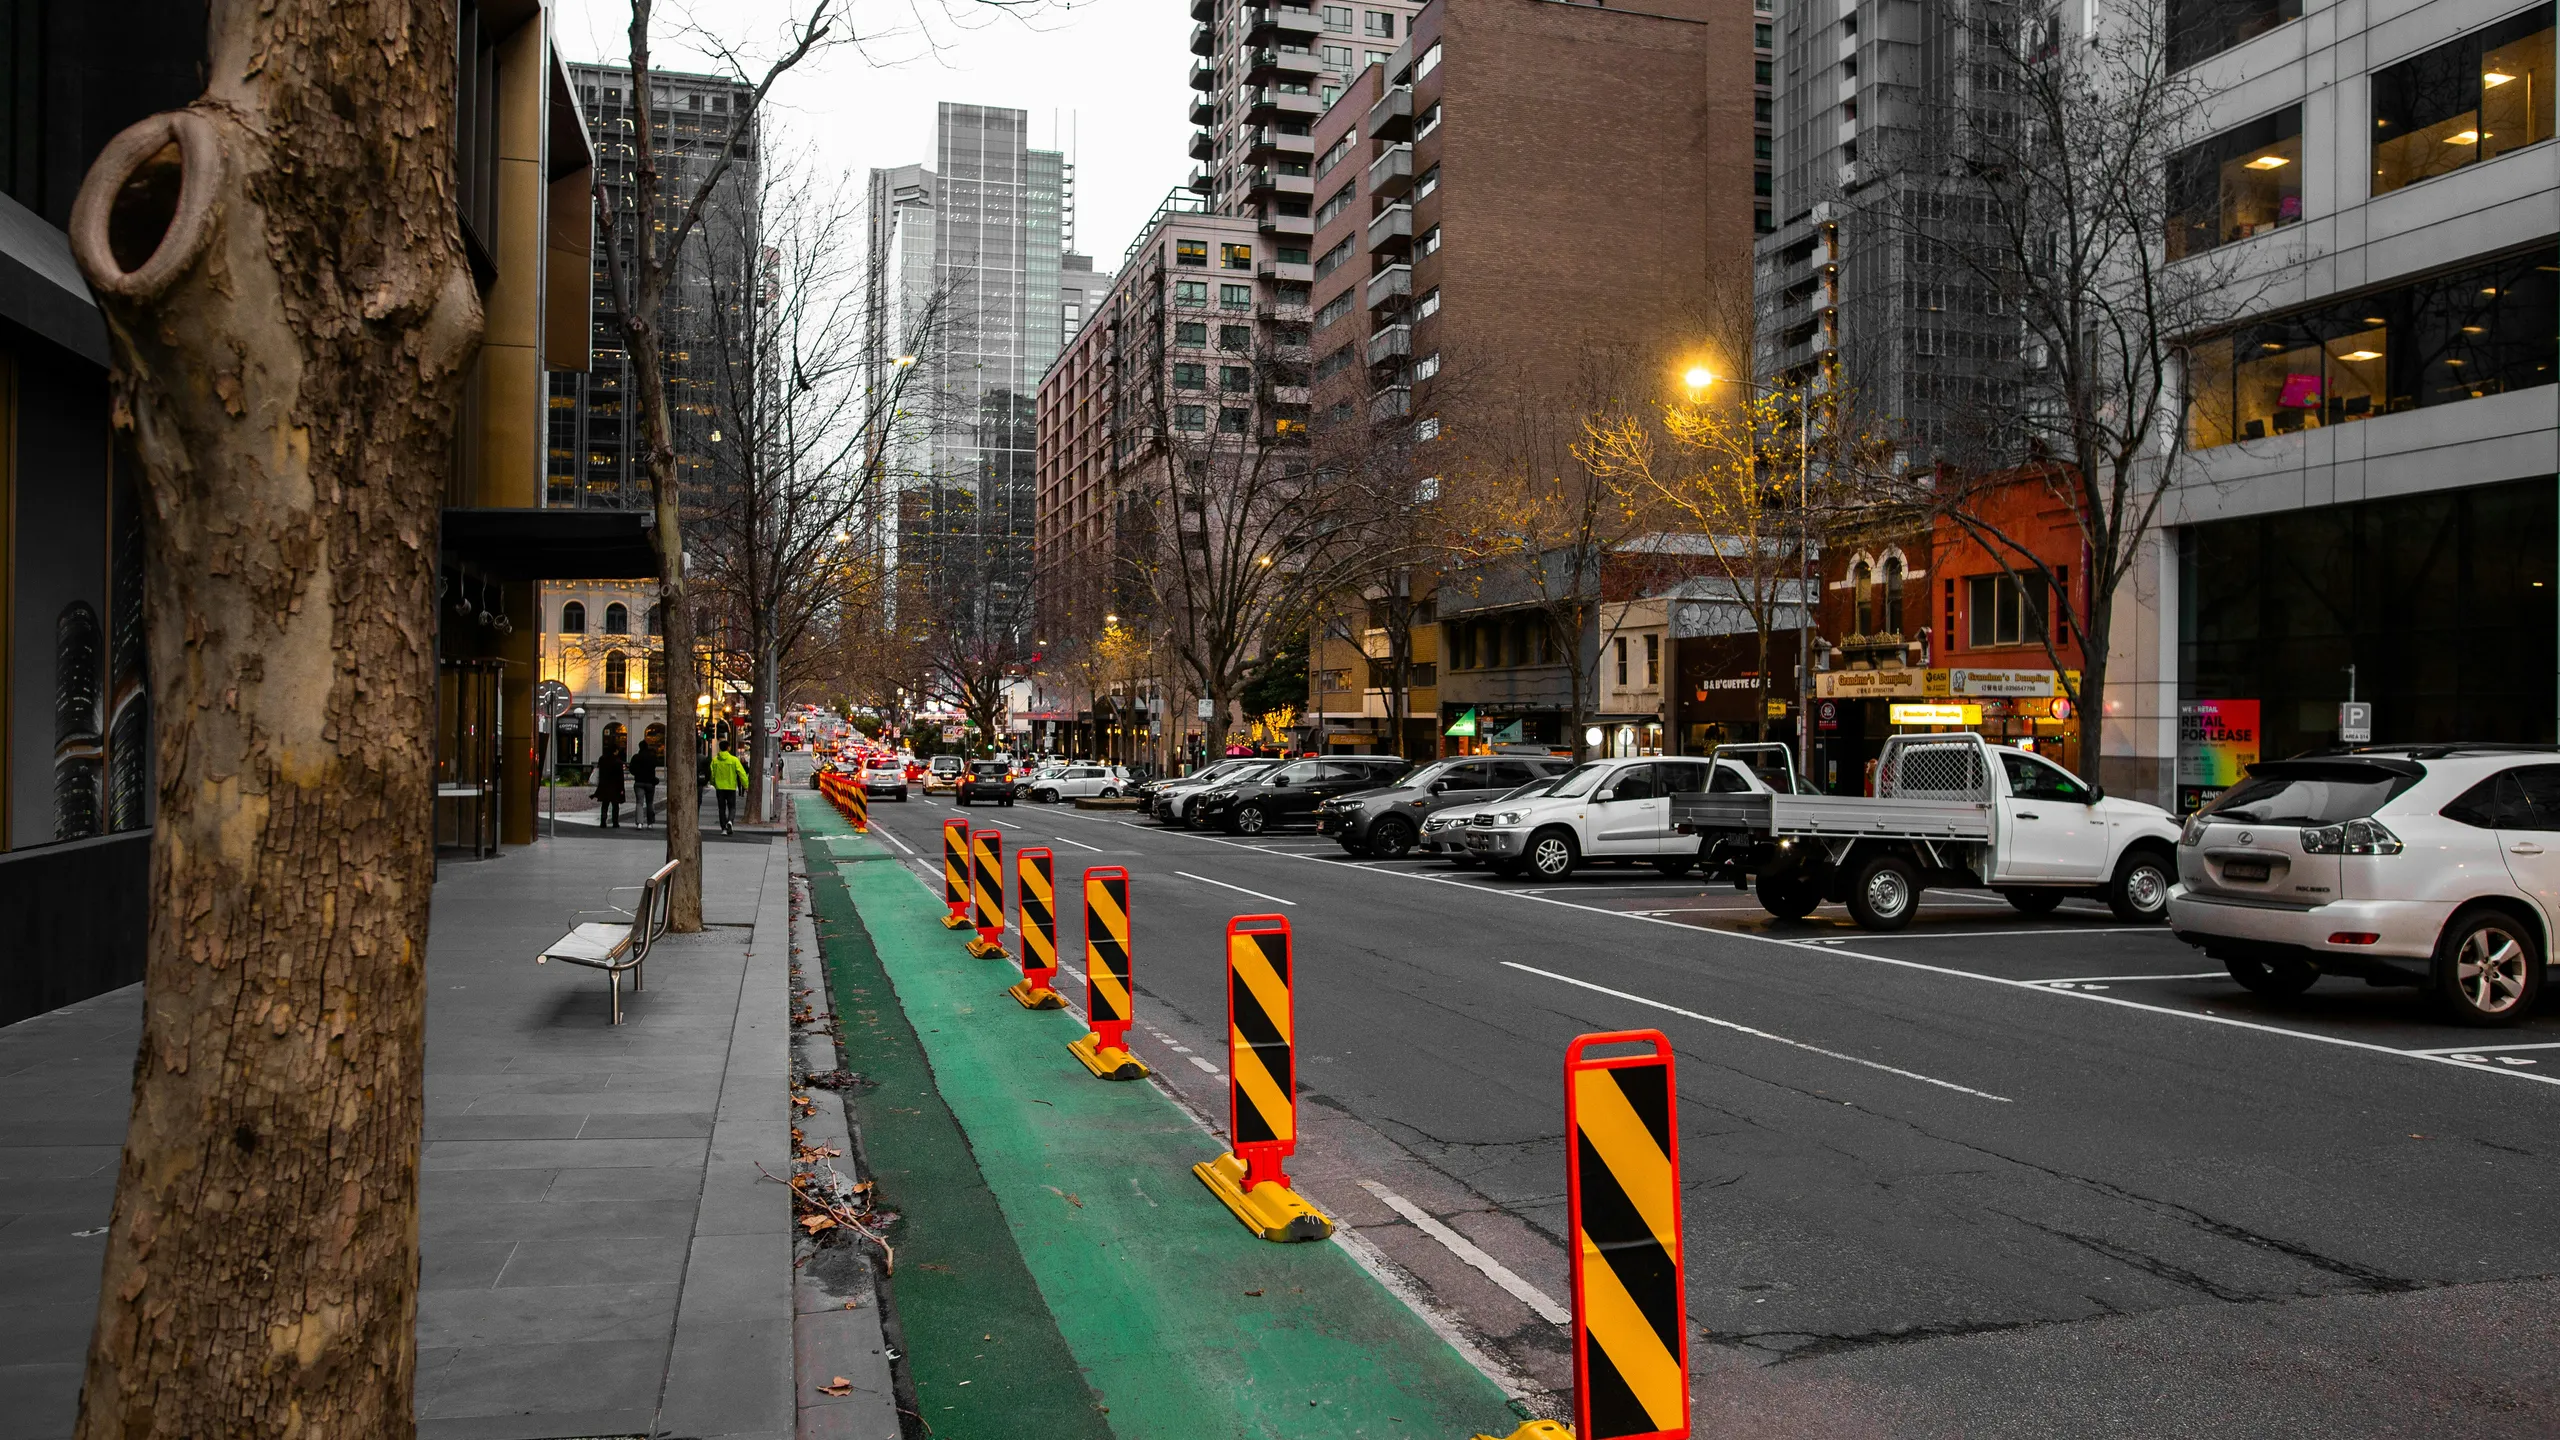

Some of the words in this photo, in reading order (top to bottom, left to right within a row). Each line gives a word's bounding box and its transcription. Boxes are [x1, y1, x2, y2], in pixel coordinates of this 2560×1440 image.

[1750, 678, 1771, 688] CAE
[1838, 674, 1875, 686] Grandma's
[1879, 673, 1912, 686] Dumpling
[1967, 672, 2010, 682] Grandma's
[2015, 673, 2050, 684] Dumpling
[2181, 715, 2226, 728] RETAIL
[2350, 707, 2364, 726] P
[2181, 729, 2207, 741] FOR
[2210, 729, 2252, 742] LEASE
